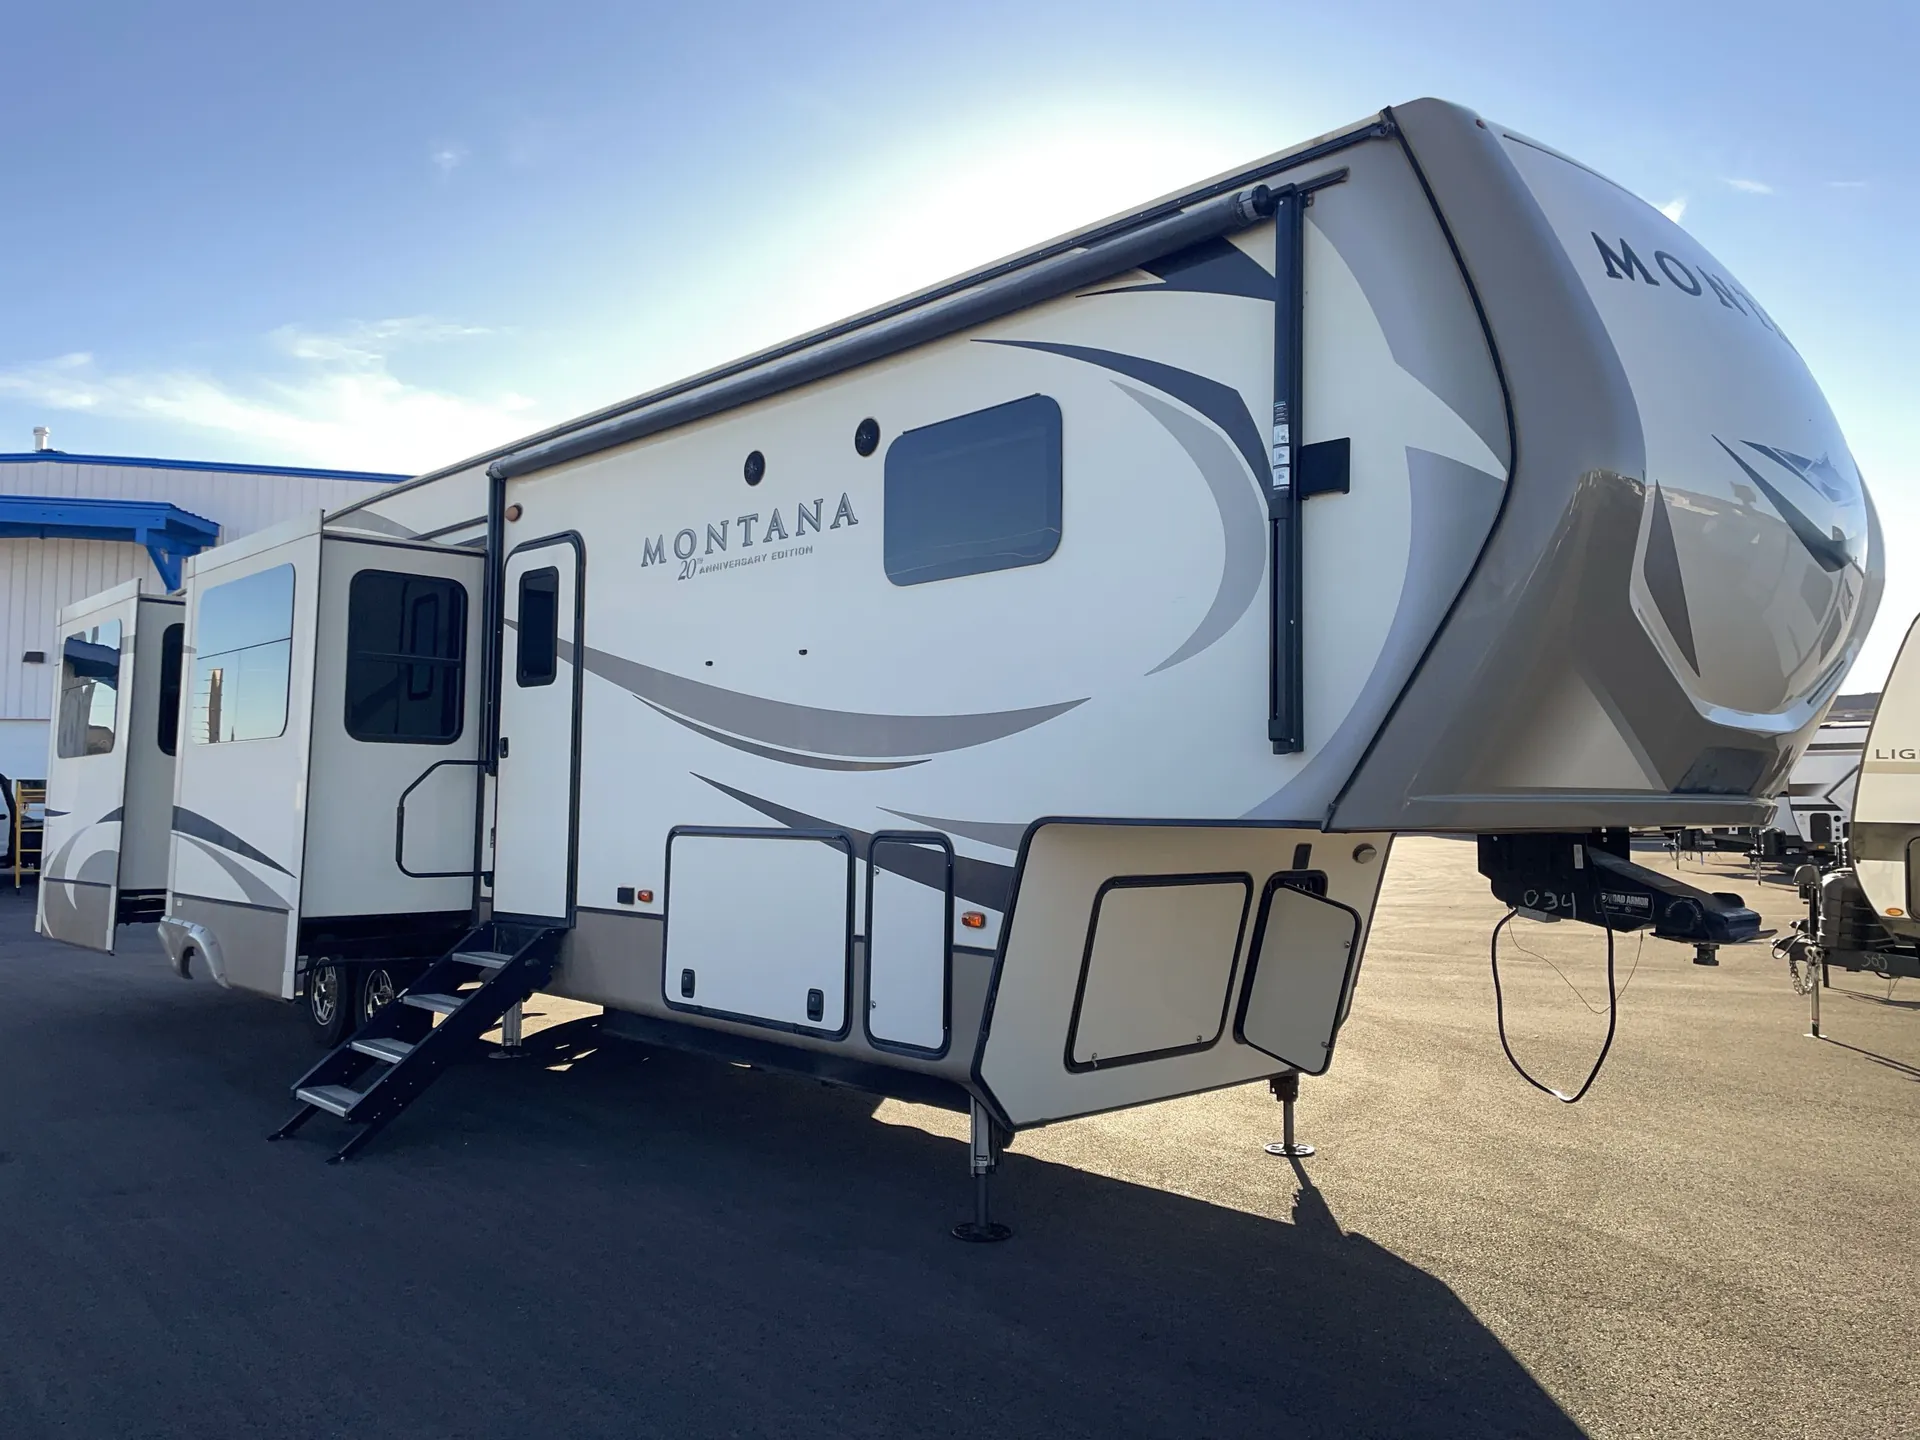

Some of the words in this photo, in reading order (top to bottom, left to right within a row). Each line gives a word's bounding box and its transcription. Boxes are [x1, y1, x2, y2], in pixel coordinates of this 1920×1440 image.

[1590, 231, 1786, 342] MONT
[641, 492, 859, 567] MONTANA
[699, 553, 767, 574] ANNIVERSARY
[771, 545, 813, 561] EDITION
[1875, 748, 1920, 760] LIG
[1524, 889, 1577, 919] 034
